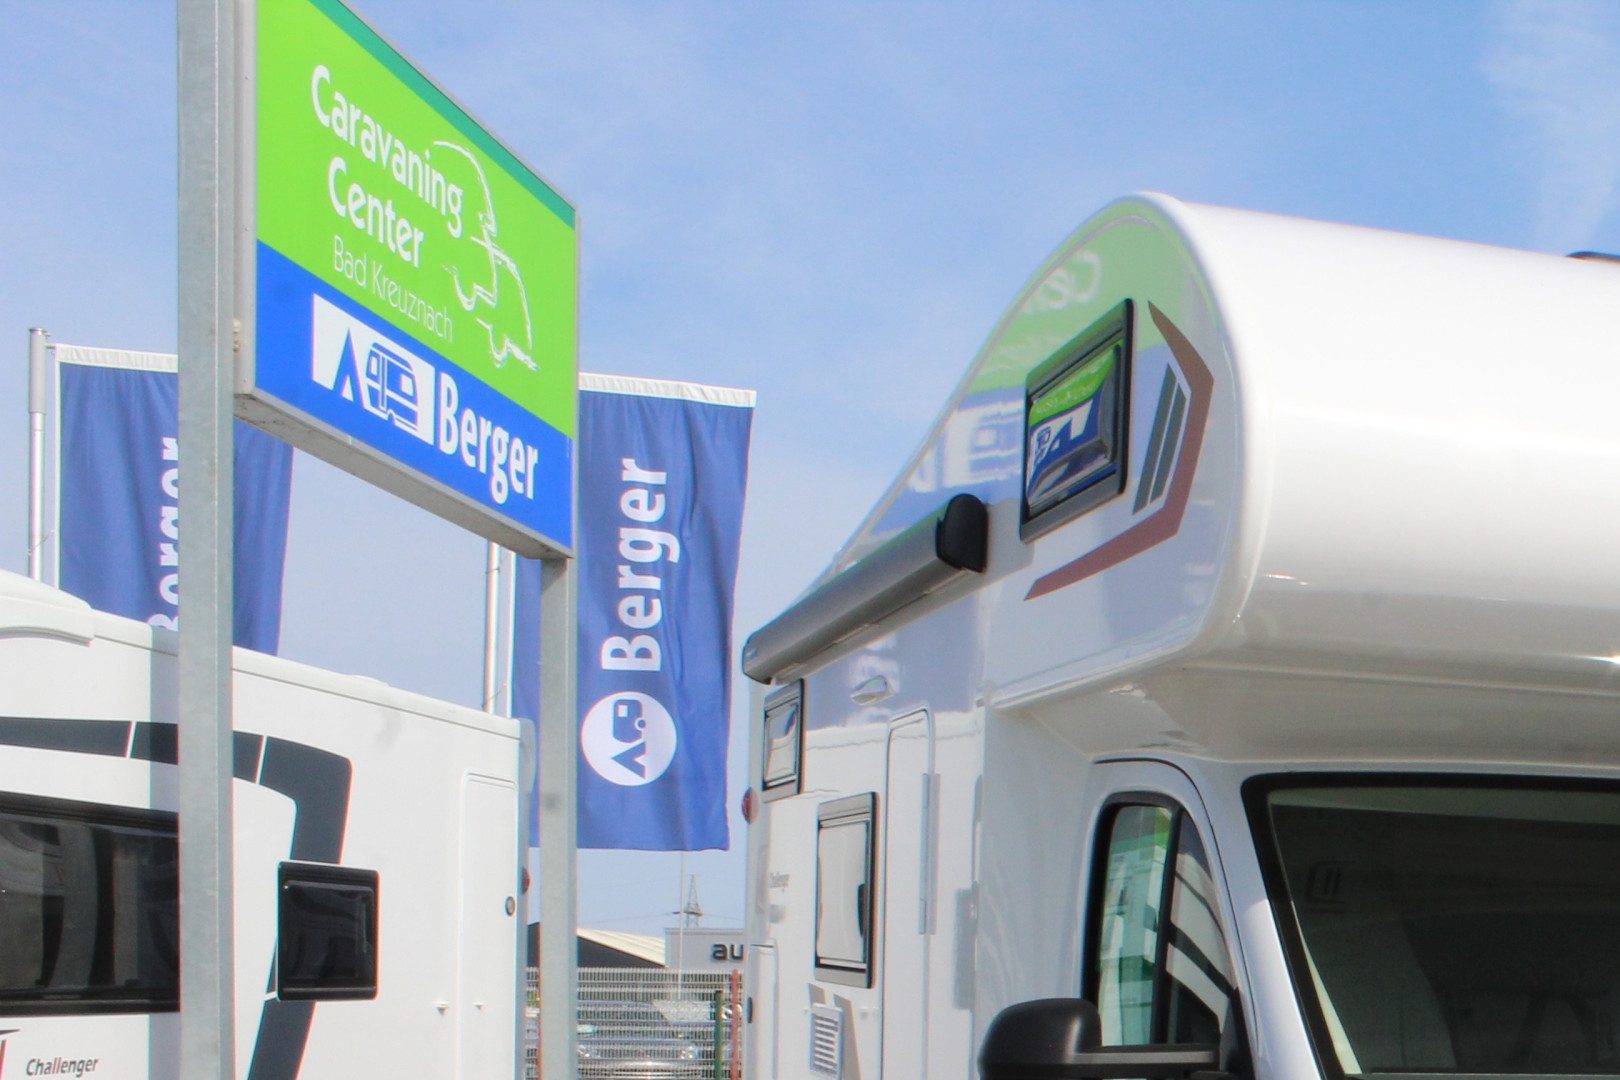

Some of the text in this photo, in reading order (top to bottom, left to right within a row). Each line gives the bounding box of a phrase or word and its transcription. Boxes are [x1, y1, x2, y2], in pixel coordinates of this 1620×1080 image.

[311, 64, 464, 238] Caravaning
[328, 156, 424, 268] Center
[333, 234, 454, 344] Bad Kreuznach
[438, 371, 540, 505] Berger
[600, 457, 681, 672] Berger
[26, 1056, 99, 1078] Challenger
